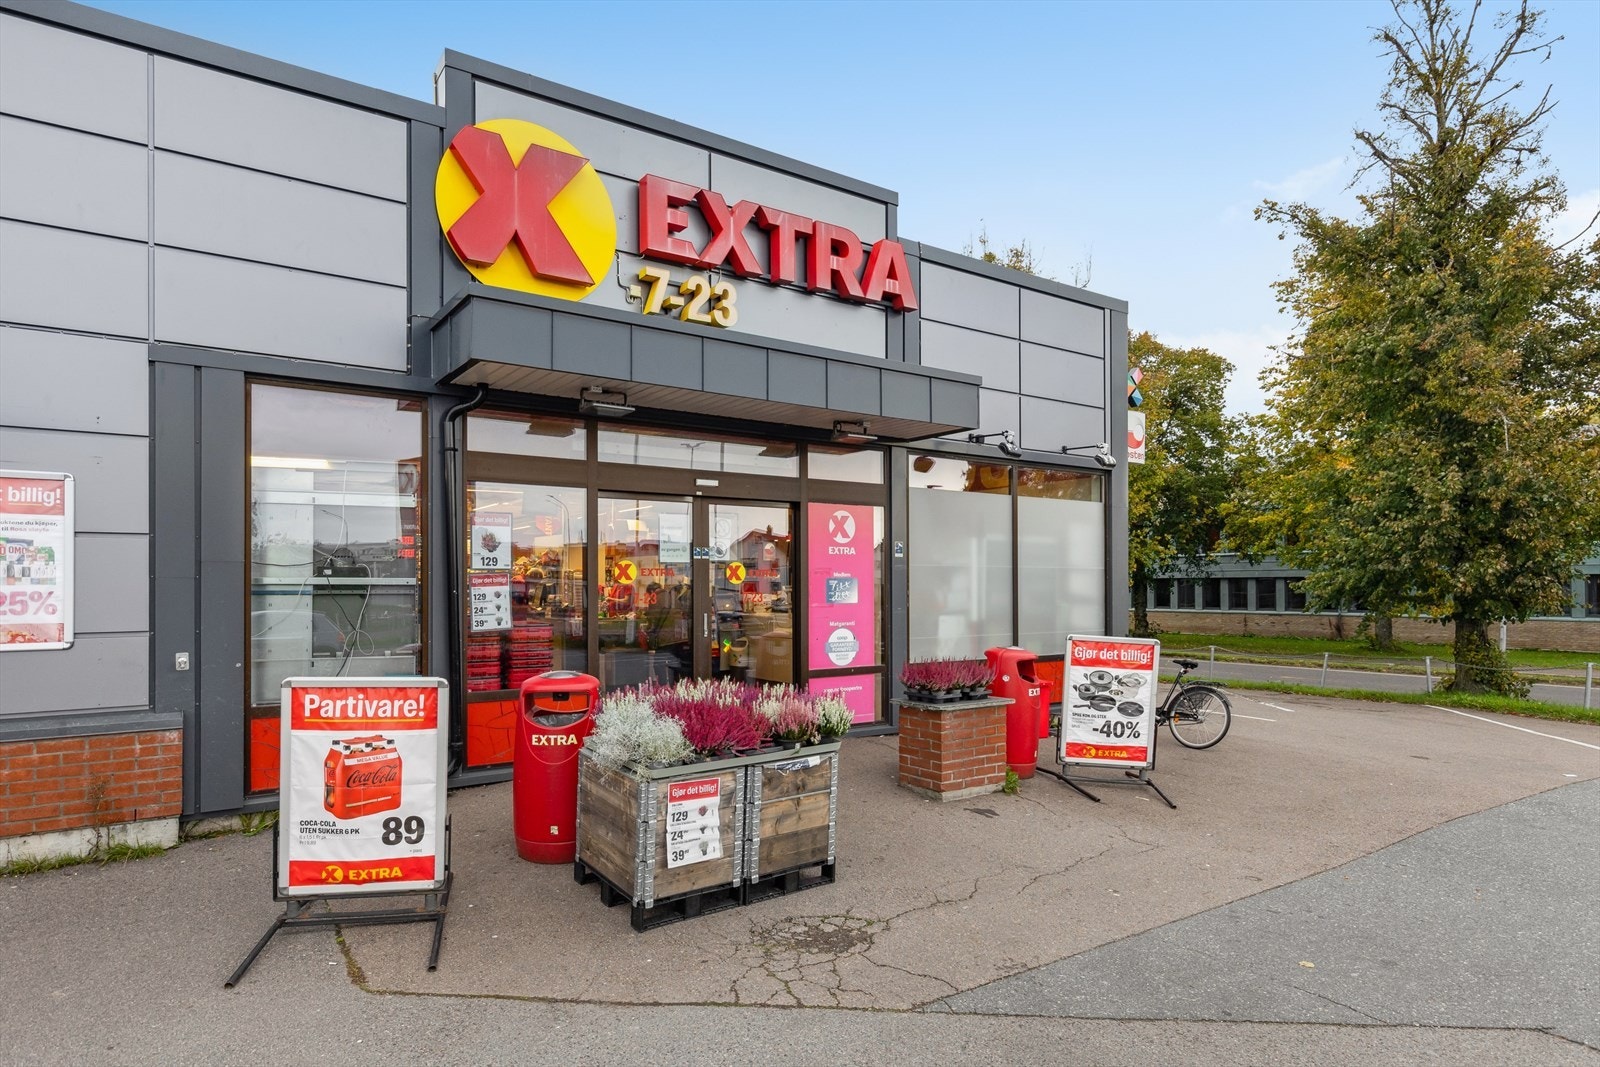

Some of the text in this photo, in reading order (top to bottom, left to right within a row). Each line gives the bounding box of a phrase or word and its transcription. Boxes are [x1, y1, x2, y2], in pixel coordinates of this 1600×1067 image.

[638, 173, 918, 313] EXTRA
[638, 266, 739, 328] 7-23
[8, 486, 61, 507] billig!
[828, 546, 856, 555] EXTRA
[480, 556, 498, 567] 129
[640, 567, 675, 577] EXTRA
[473, 593, 487, 601] 129
[473, 606, 484, 614] 24
[1074, 646, 1151, 664] Gjør det billig!
[304, 693, 425, 718] Partivare!
[1092, 720, 1140, 738] -40%
[531, 734, 578, 746] EXTRA
[1098, 749, 1128, 758] EXTRA
[672, 784, 717, 798] Gjør det billig!
[671, 810, 688, 823] 129
[300, 820, 336, 828] COCA-COLA
[382, 815, 425, 846] 89
[317, 827, 343, 835] SUKKER
[671, 830, 683, 841] 24
[672, 849, 684, 862] 39
[349, 866, 403, 880] EXTRA
